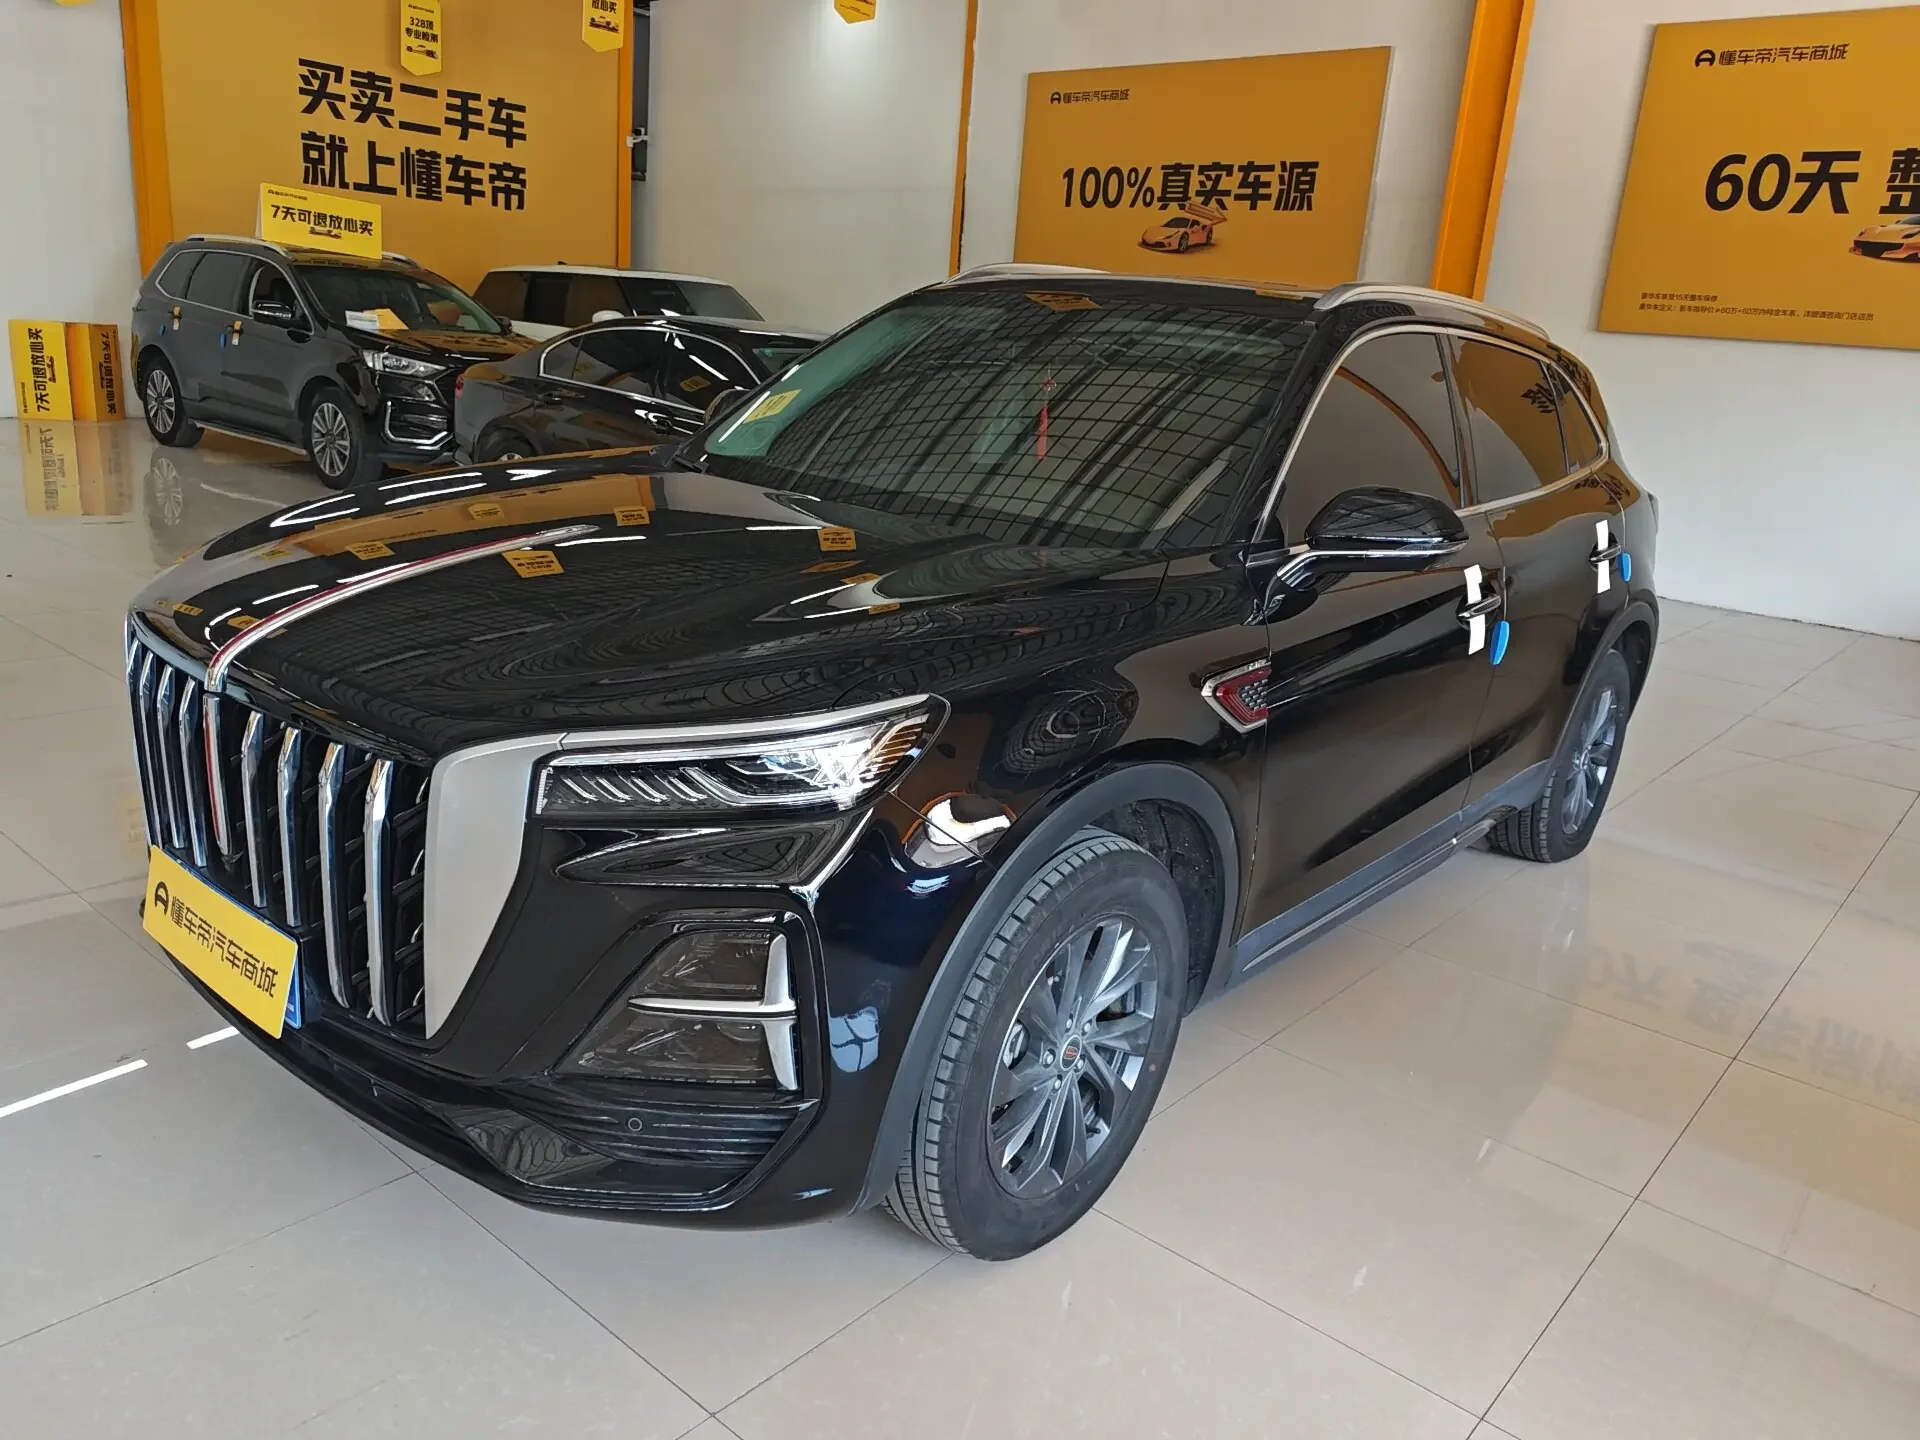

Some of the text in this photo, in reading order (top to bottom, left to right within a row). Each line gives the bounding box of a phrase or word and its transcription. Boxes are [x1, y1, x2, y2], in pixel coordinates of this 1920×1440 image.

[405, 27, 439, 44] 专业检测
[409, 16, 434, 31] 328项
[1718, 43, 1850, 66] 懂车帝汽车商城
[298, 57, 527, 149] 买卖二手车
[300, 130, 527, 211] 就上懂车帝
[1061, 160, 1320, 212] 100%真实车源
[1705, 151, 1862, 214] 60天
[270, 204, 374, 236] 7天可退放心买
[28, 328, 50, 412] 7天可退放心买
[170, 896, 279, 998] 懂车帝汽车商城
